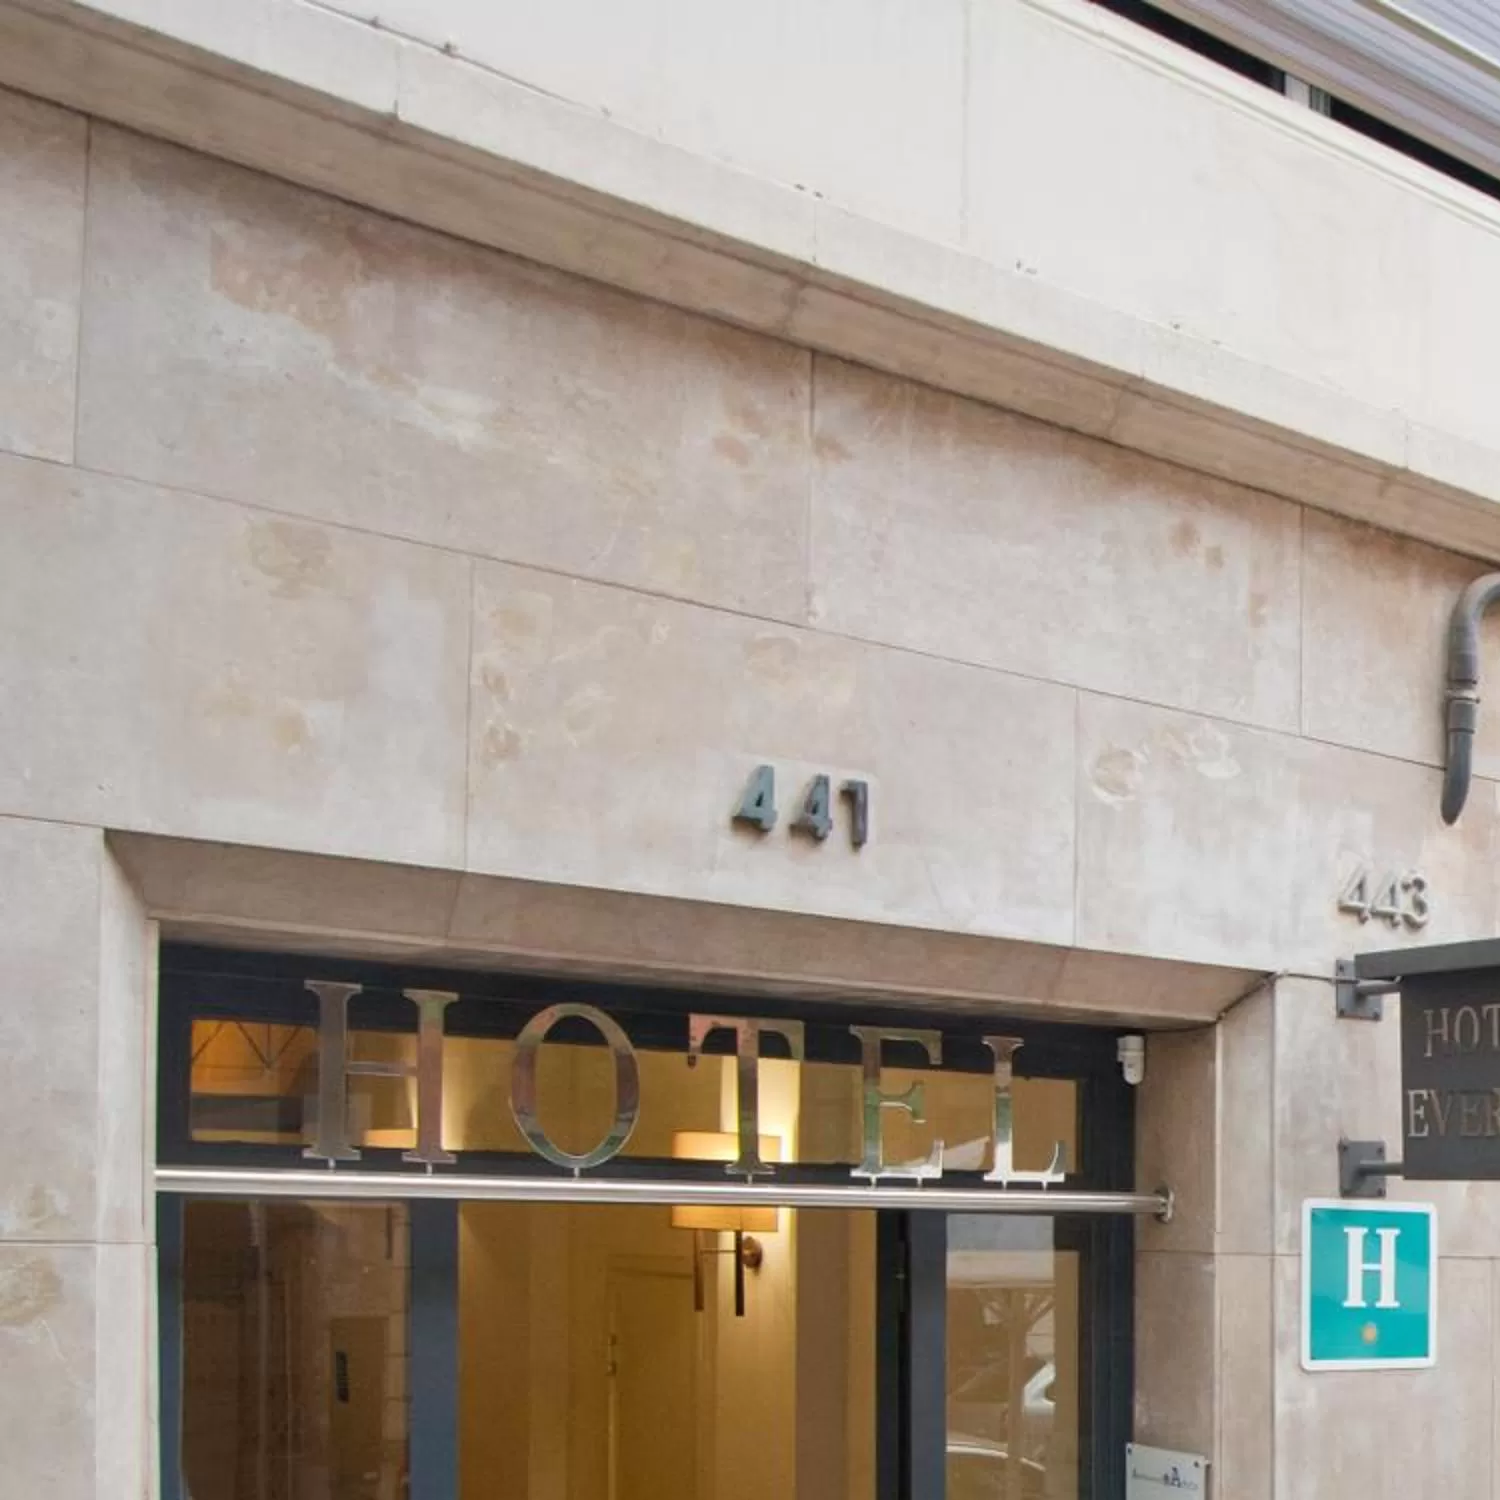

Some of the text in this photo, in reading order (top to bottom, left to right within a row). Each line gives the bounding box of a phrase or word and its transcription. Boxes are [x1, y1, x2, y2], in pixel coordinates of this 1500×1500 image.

[731, 764, 869, 852] 441
[1337, 863, 1430, 930] 443
[304, 979, 1066, 1184] HOTEL
[1342, 1226, 1401, 1308] H
